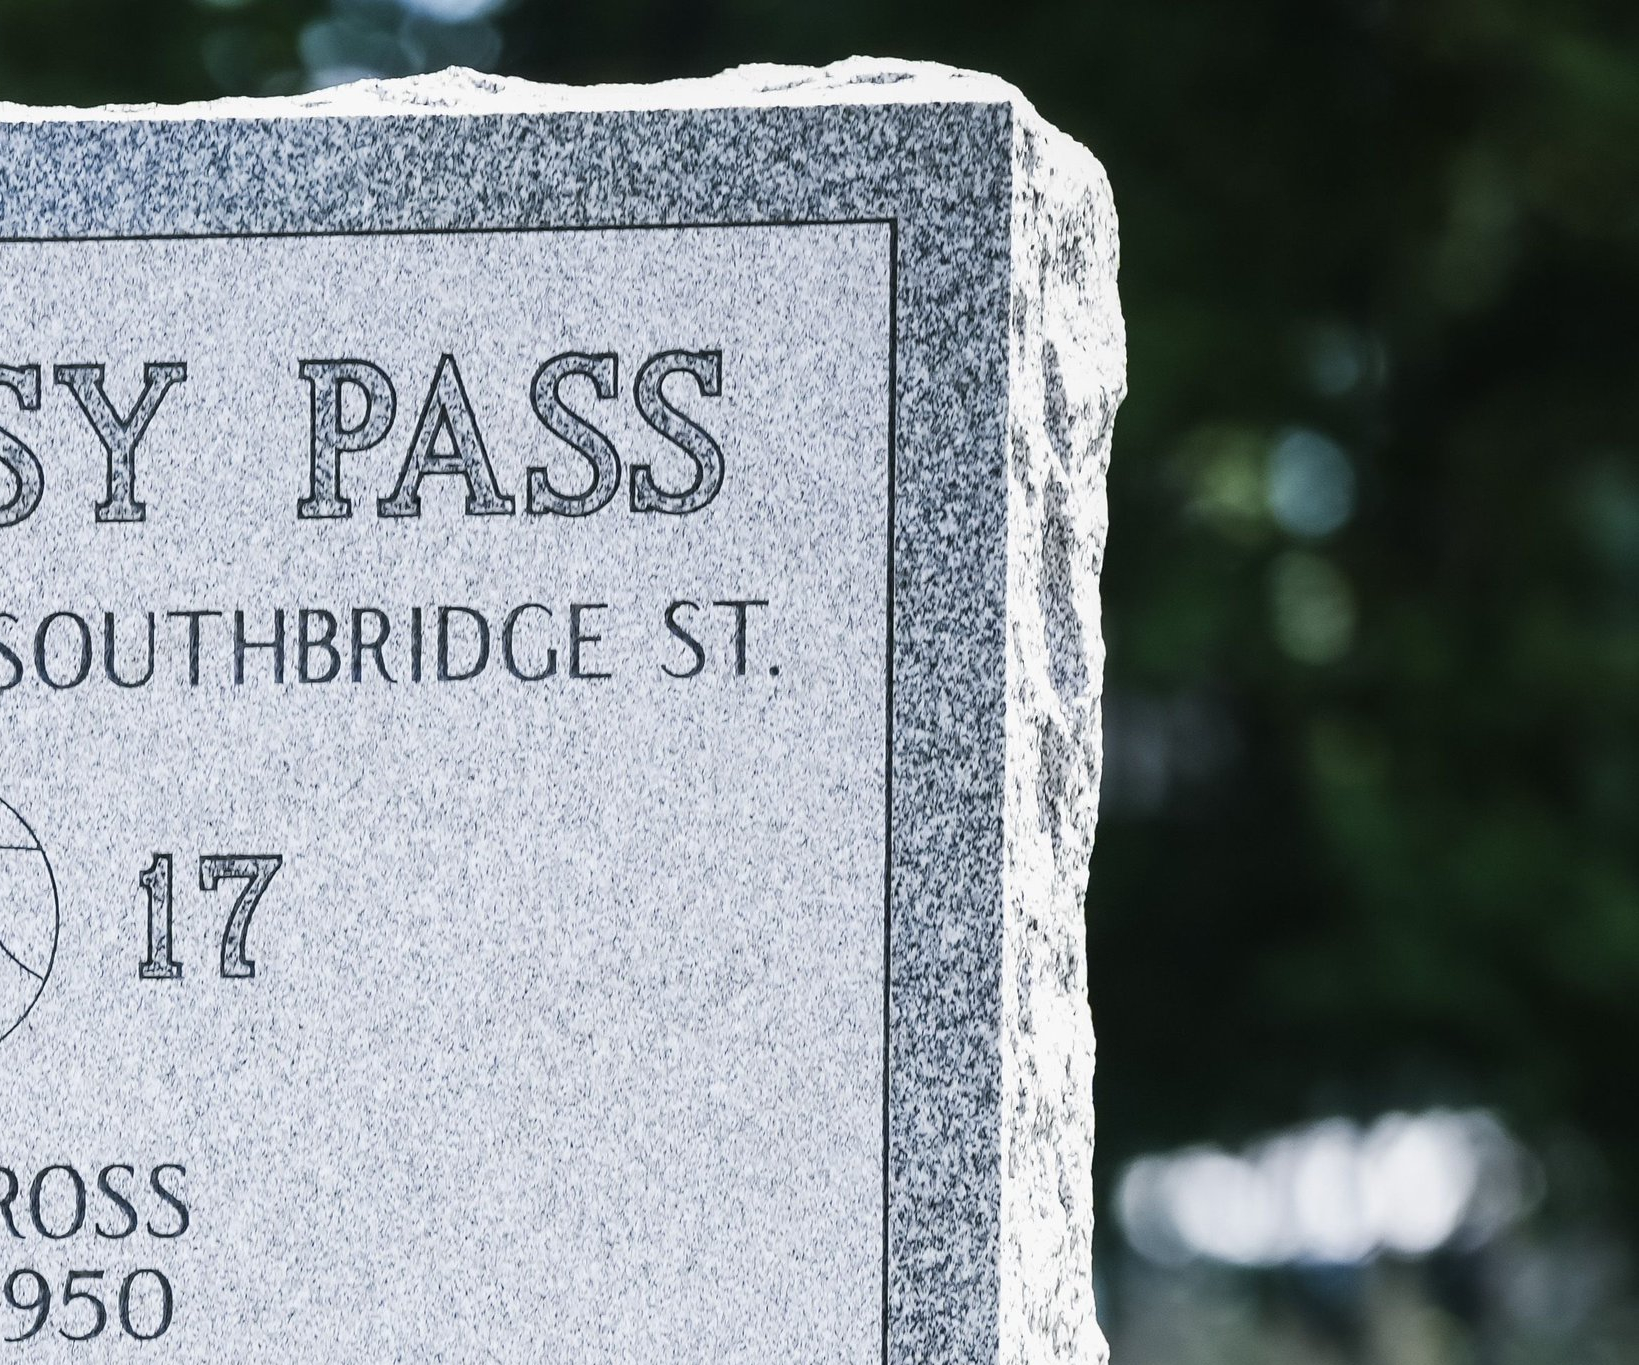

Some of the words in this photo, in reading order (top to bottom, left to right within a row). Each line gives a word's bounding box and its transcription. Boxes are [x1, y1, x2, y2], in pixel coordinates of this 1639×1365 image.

[296, 346, 727, 522] PASS
[661, 598, 784, 681] ST.
[138, 851, 284, 981] 17
